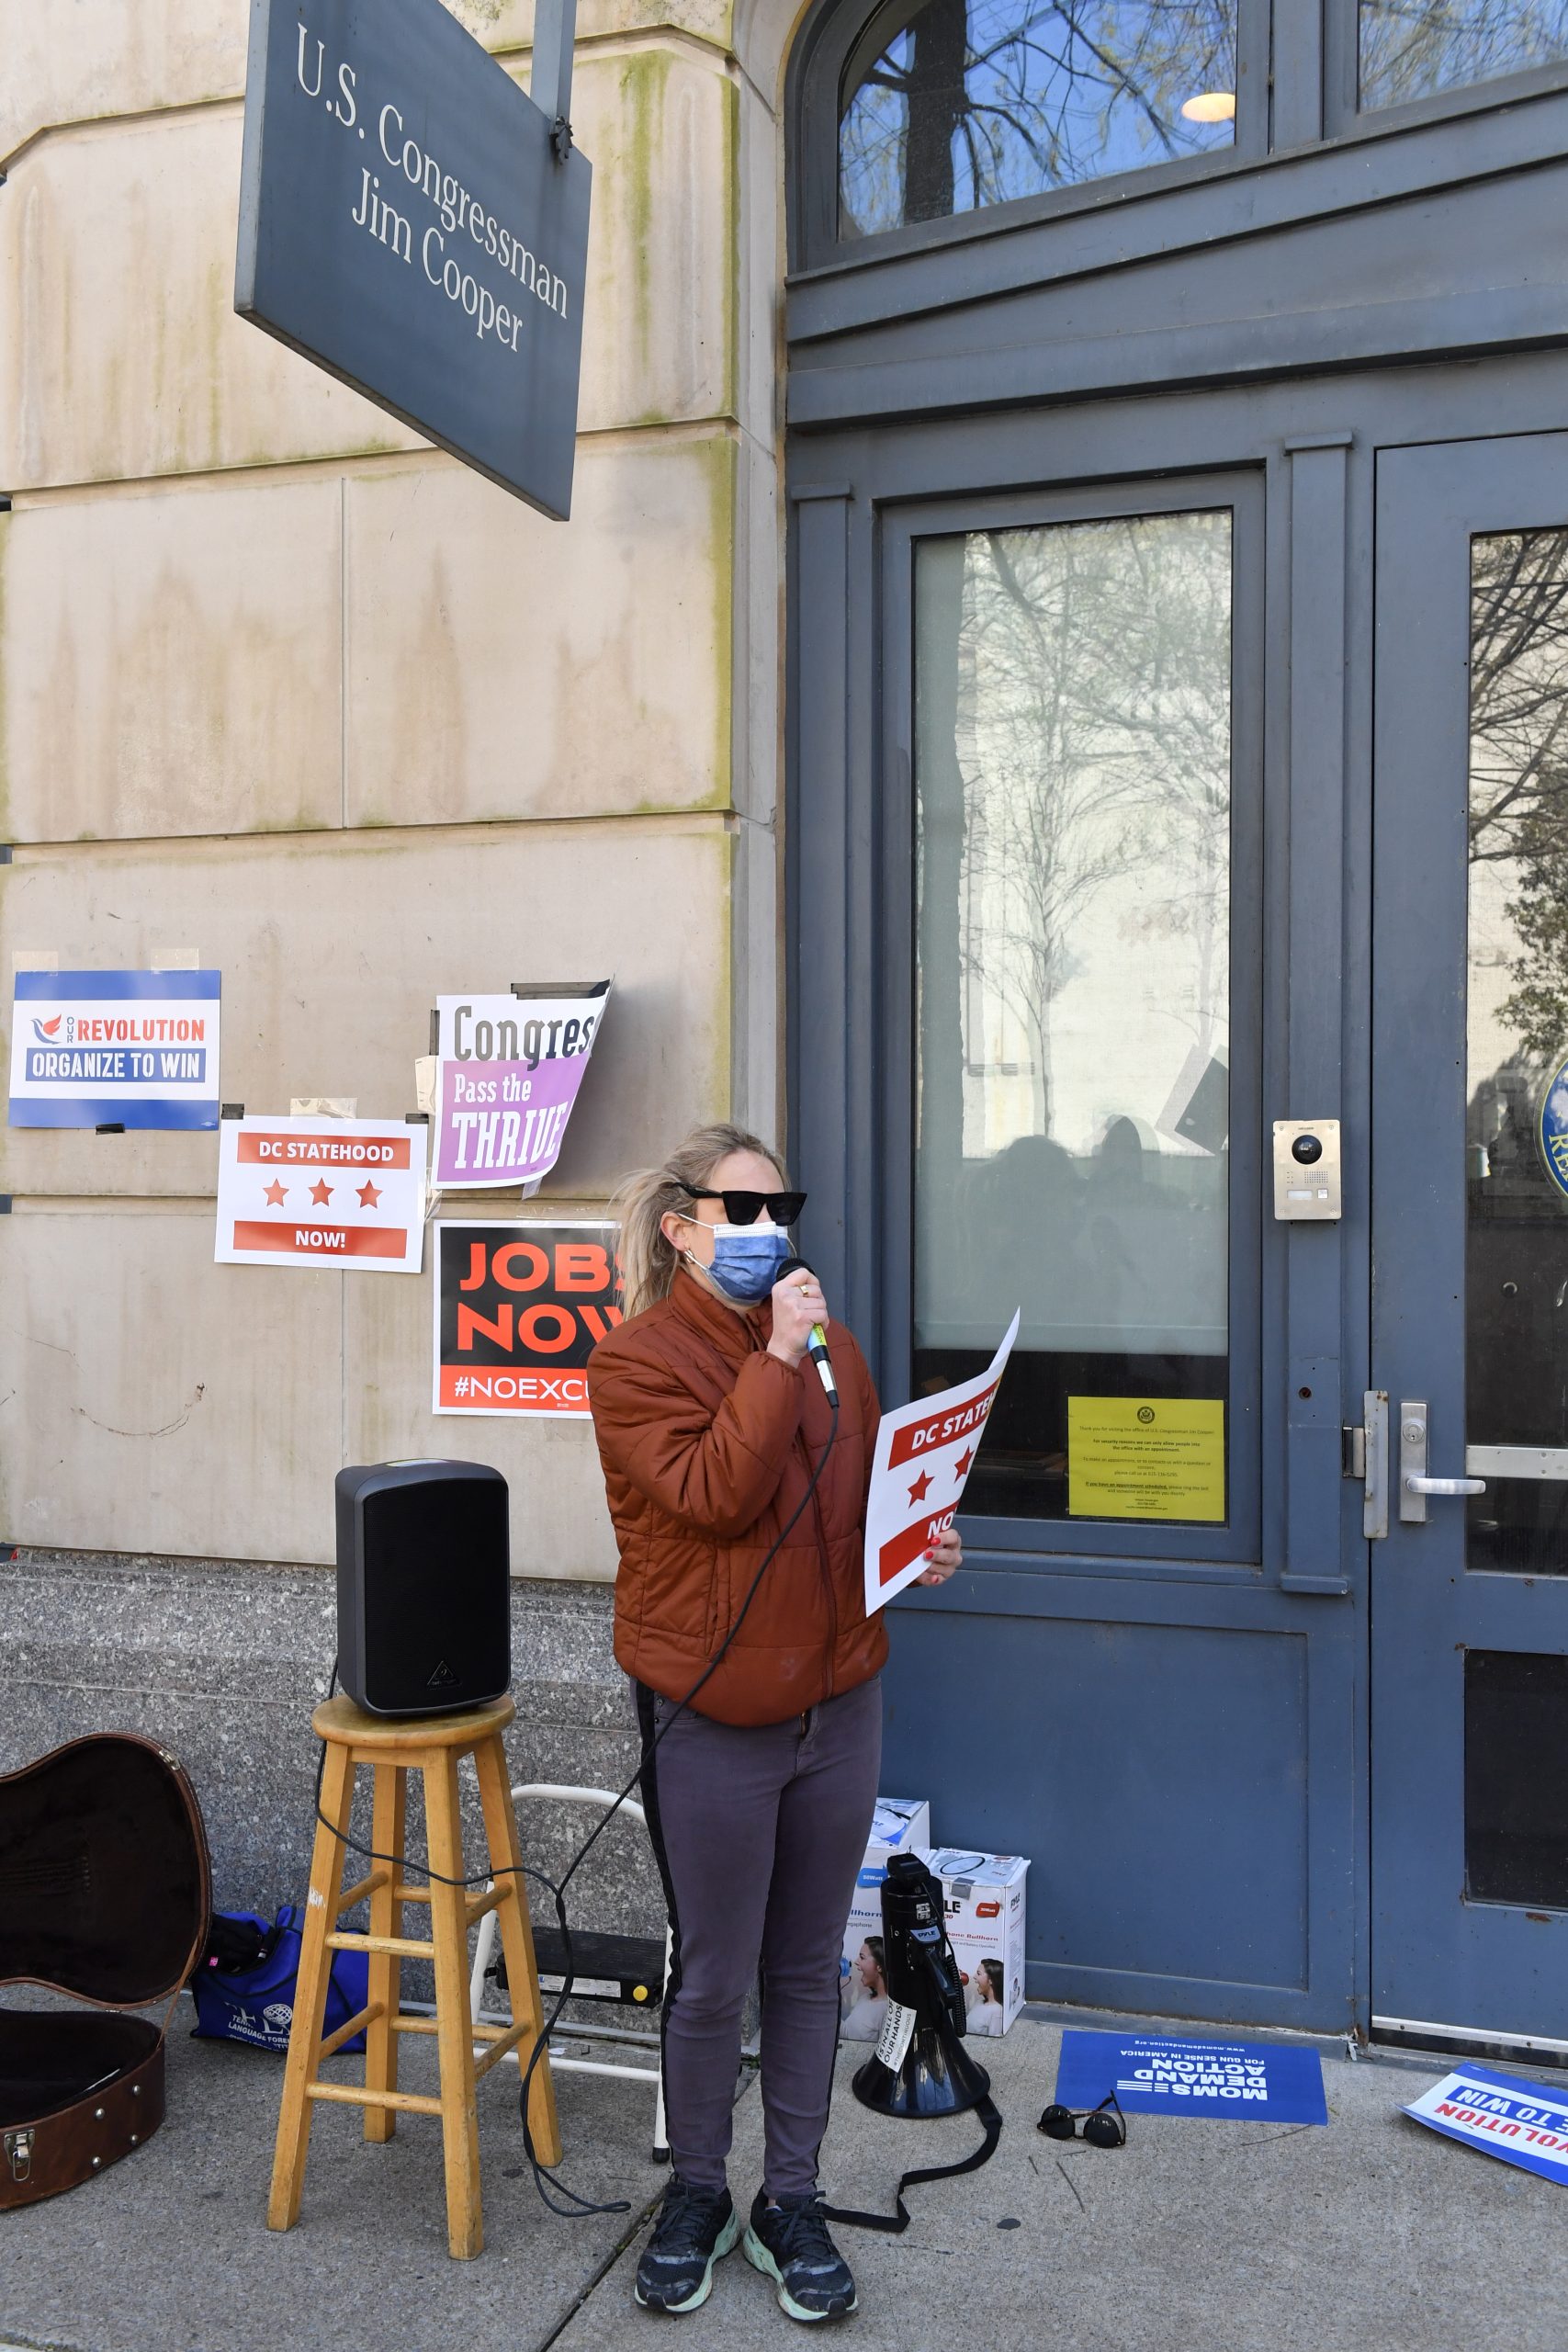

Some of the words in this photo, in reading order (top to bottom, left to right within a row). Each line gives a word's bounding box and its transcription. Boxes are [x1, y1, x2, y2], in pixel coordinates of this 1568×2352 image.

[297, 23, 365, 140] U.S.
[379, 104, 568, 320] Congressman
[352, 167, 412, 265] Jim
[423, 226, 523, 353] Cooper
[77, 1016, 205, 1042] REVOLUTION
[454, 1005, 594, 1072] Congres
[31, 1052, 125, 1079] ORGANIZE
[130, 1052, 154, 1078] TO
[160, 1053, 200, 1079] WIN
[454, 1073, 497, 1103] Pass
[502, 1073, 532, 1102] the
[258, 1141, 283, 1159] DC
[287, 1142, 394, 1162] STATEHOOD
[295, 1229, 346, 1249] NOW!
[455, 1376, 590, 1401] #NOEXC
[911, 1423, 938, 1451] DC
[928, 1507, 957, 1540] NO
[884, 2041, 895, 2063] OUR
[892, 2005, 903, 2041] HANDS
[1134, 2040, 1246, 2052] www.momsdemandaction.org
[1120, 2050, 1168, 2058] AMERICA
[1151, 2058, 1266, 2075] ACTION
[1134, 2069, 1267, 2088] DEMAND
[1171, 2084, 1269, 2101] MOMS
[1456, 2087, 1512, 2114] WIN
[1516, 2107, 1552, 2127] TO
